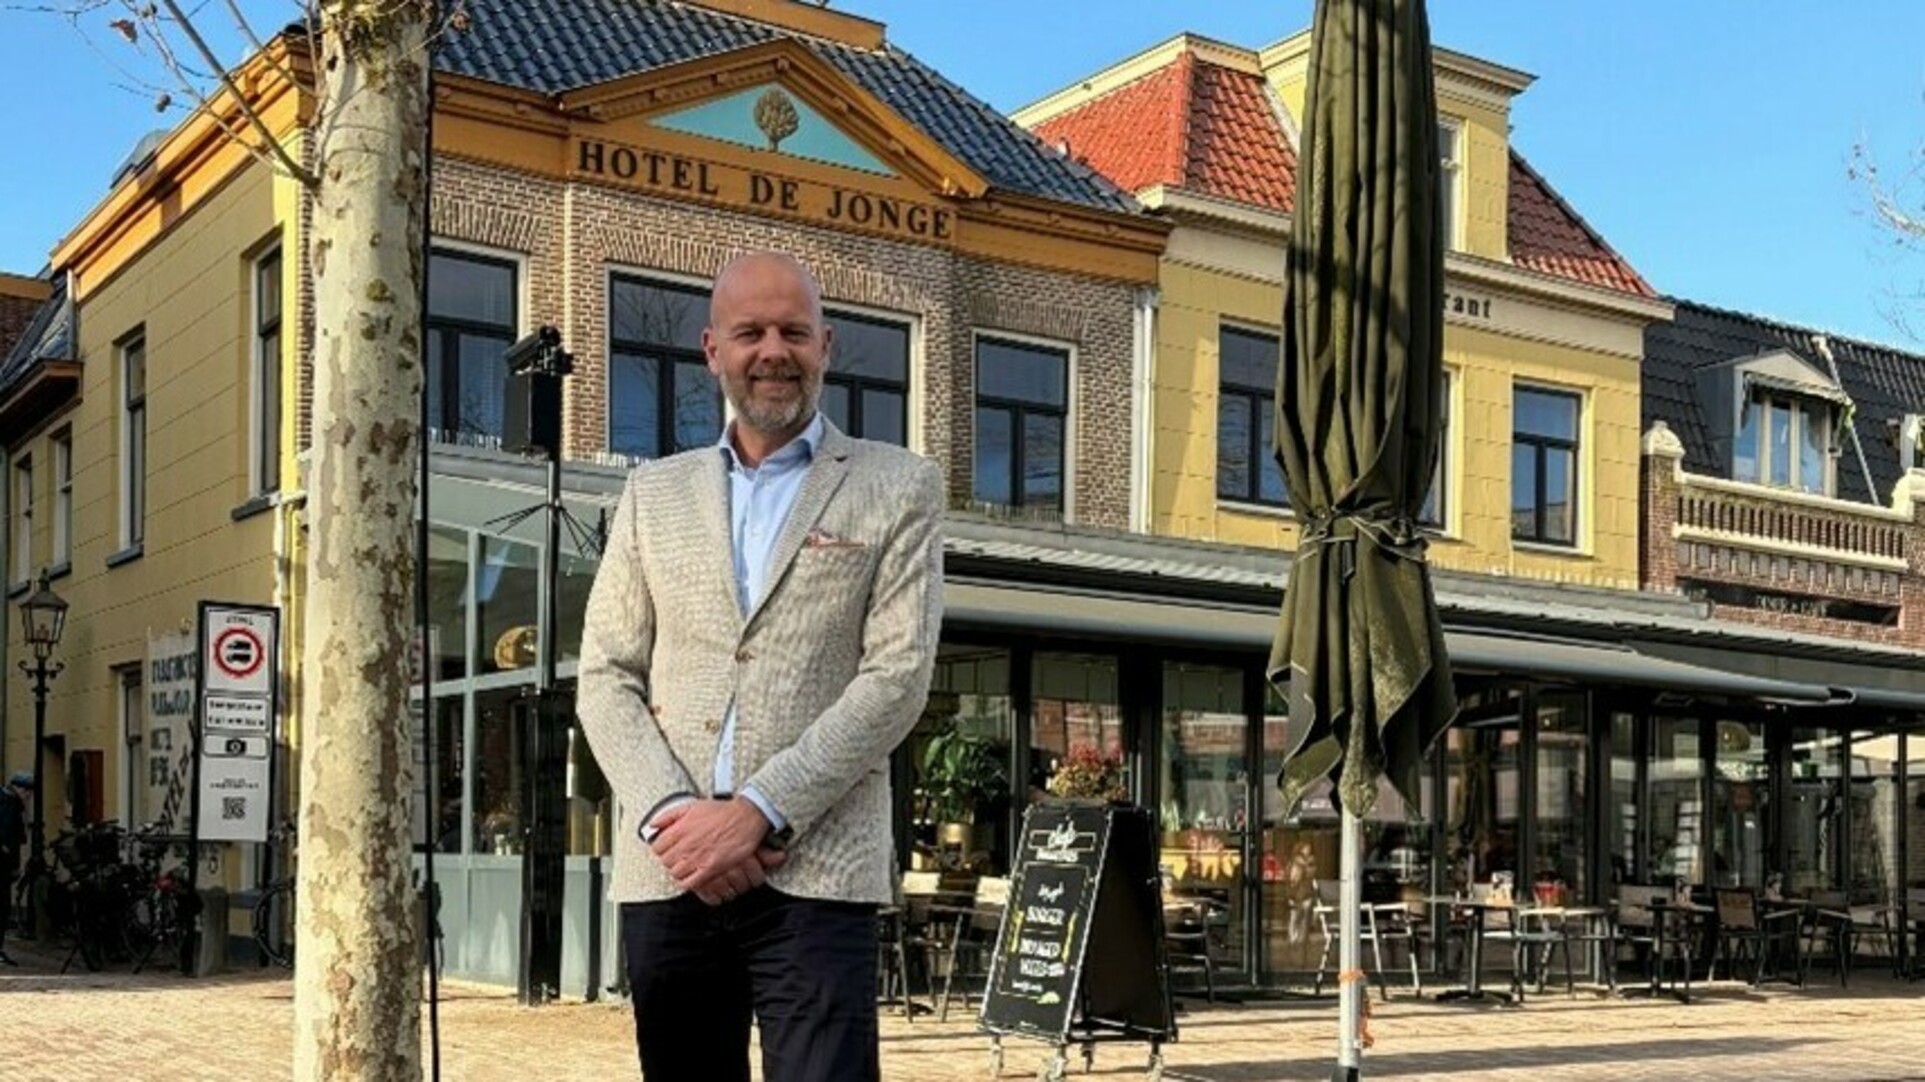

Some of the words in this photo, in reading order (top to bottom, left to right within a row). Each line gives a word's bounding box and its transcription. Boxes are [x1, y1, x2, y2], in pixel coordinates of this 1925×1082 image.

[578, 140, 718, 196] HOTEL
[750, 173, 800, 211] DE
[827, 185, 954, 239] JONGE
